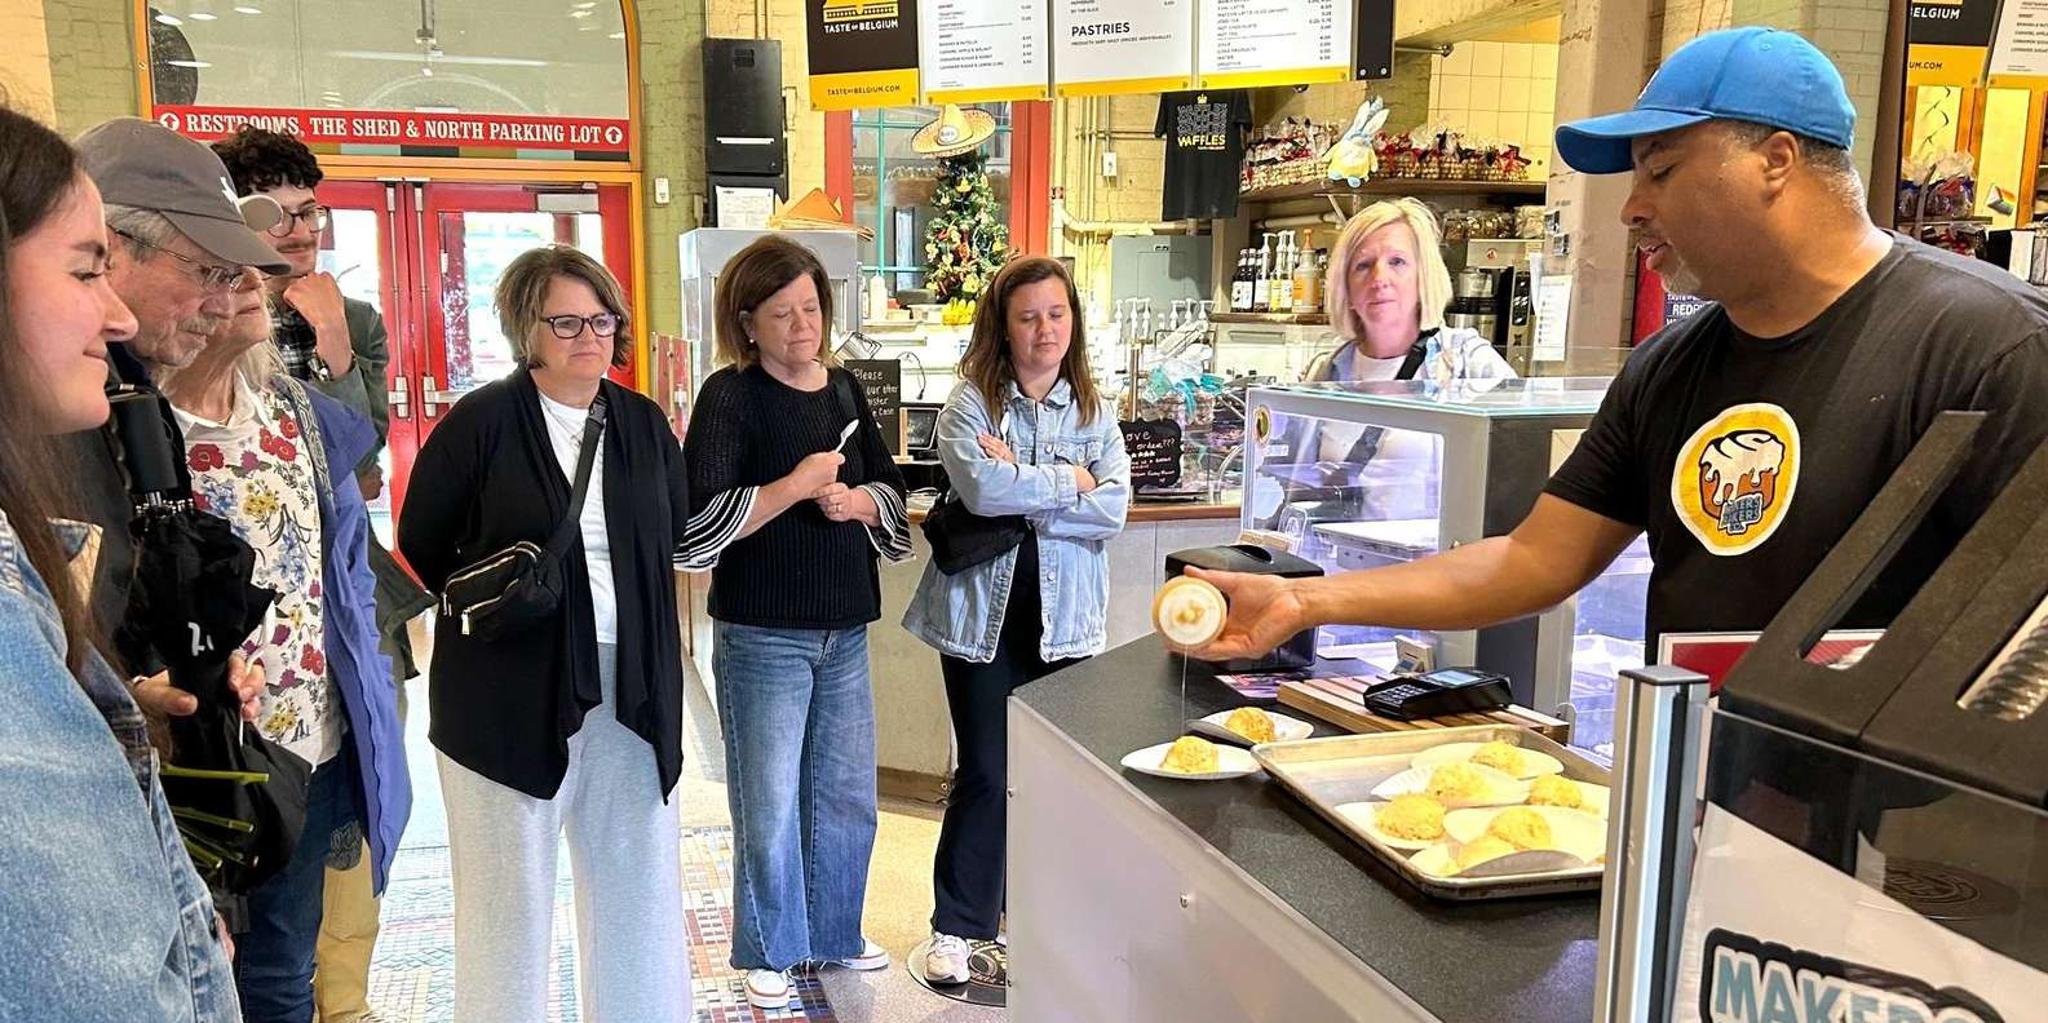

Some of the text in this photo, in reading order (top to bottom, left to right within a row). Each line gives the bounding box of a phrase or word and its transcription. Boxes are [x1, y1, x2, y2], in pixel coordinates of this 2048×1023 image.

[1910, 7, 1960, 19] ELGIUM
[824, 23, 851, 33] TASTE
[859, 19, 898, 31] BELGIUM
[1071, 22, 1130, 37] PASTRIES
[1909, 61, 1943, 70] UM.COM
[310, 117, 347, 136] THE
[352, 118, 401, 138] SHED
[406, 120, 419, 138] &
[424, 121, 484, 140] NORTH
[490, 123, 565, 142] PARKING
[569, 125, 601, 144] LOT
[1177, 134, 1225, 147] WAFFLES
[1672, 303, 1704, 316] REDP
[853, 368, 883, 381] Please
[1126, 431, 1151, 441] ove
[1714, 953, 1968, 1023] MAKE
